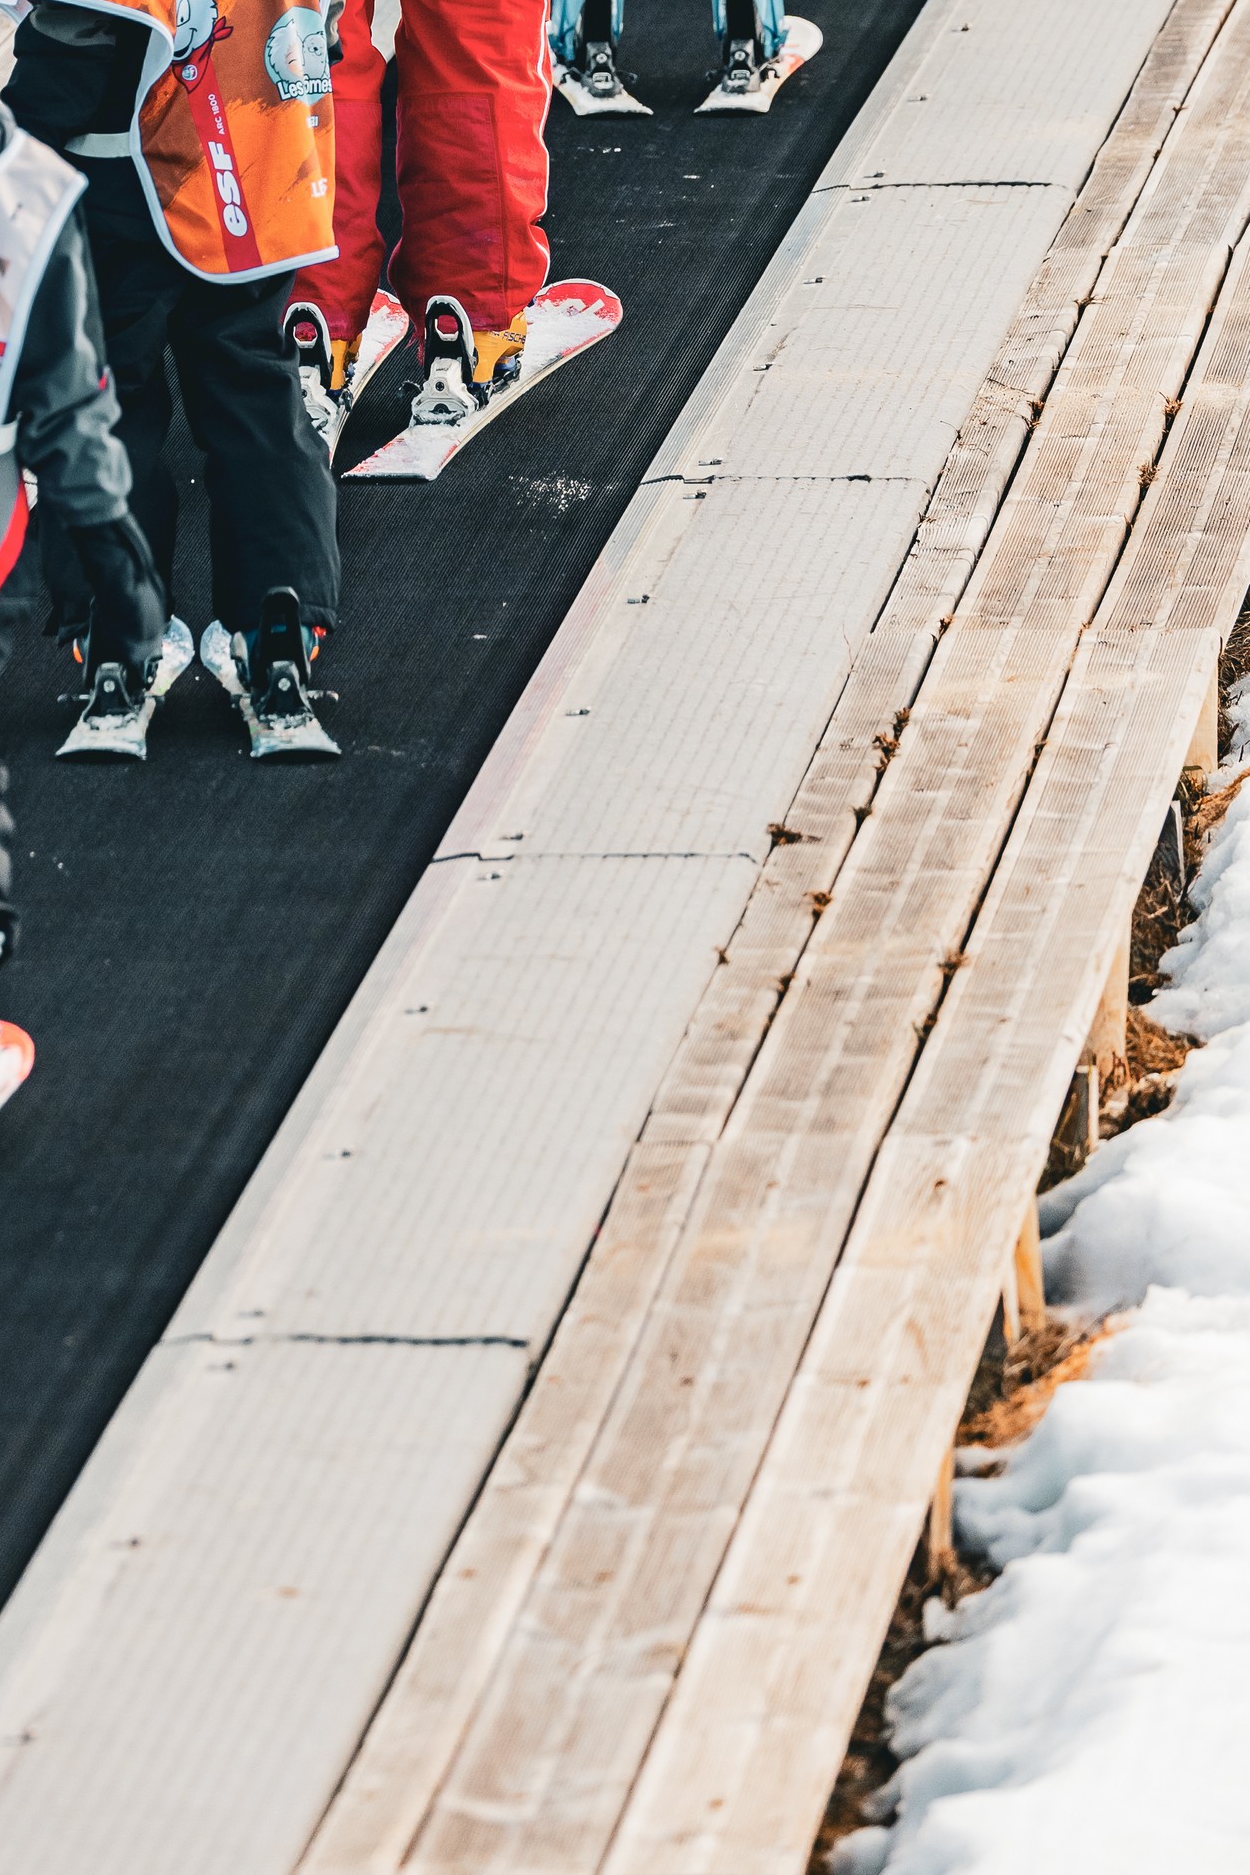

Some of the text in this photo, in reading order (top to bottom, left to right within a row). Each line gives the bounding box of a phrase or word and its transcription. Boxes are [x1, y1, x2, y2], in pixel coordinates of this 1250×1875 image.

[276, 80, 304, 101] Les
[207, 93, 220, 115] 1800
[214, 116, 226, 135] ARC
